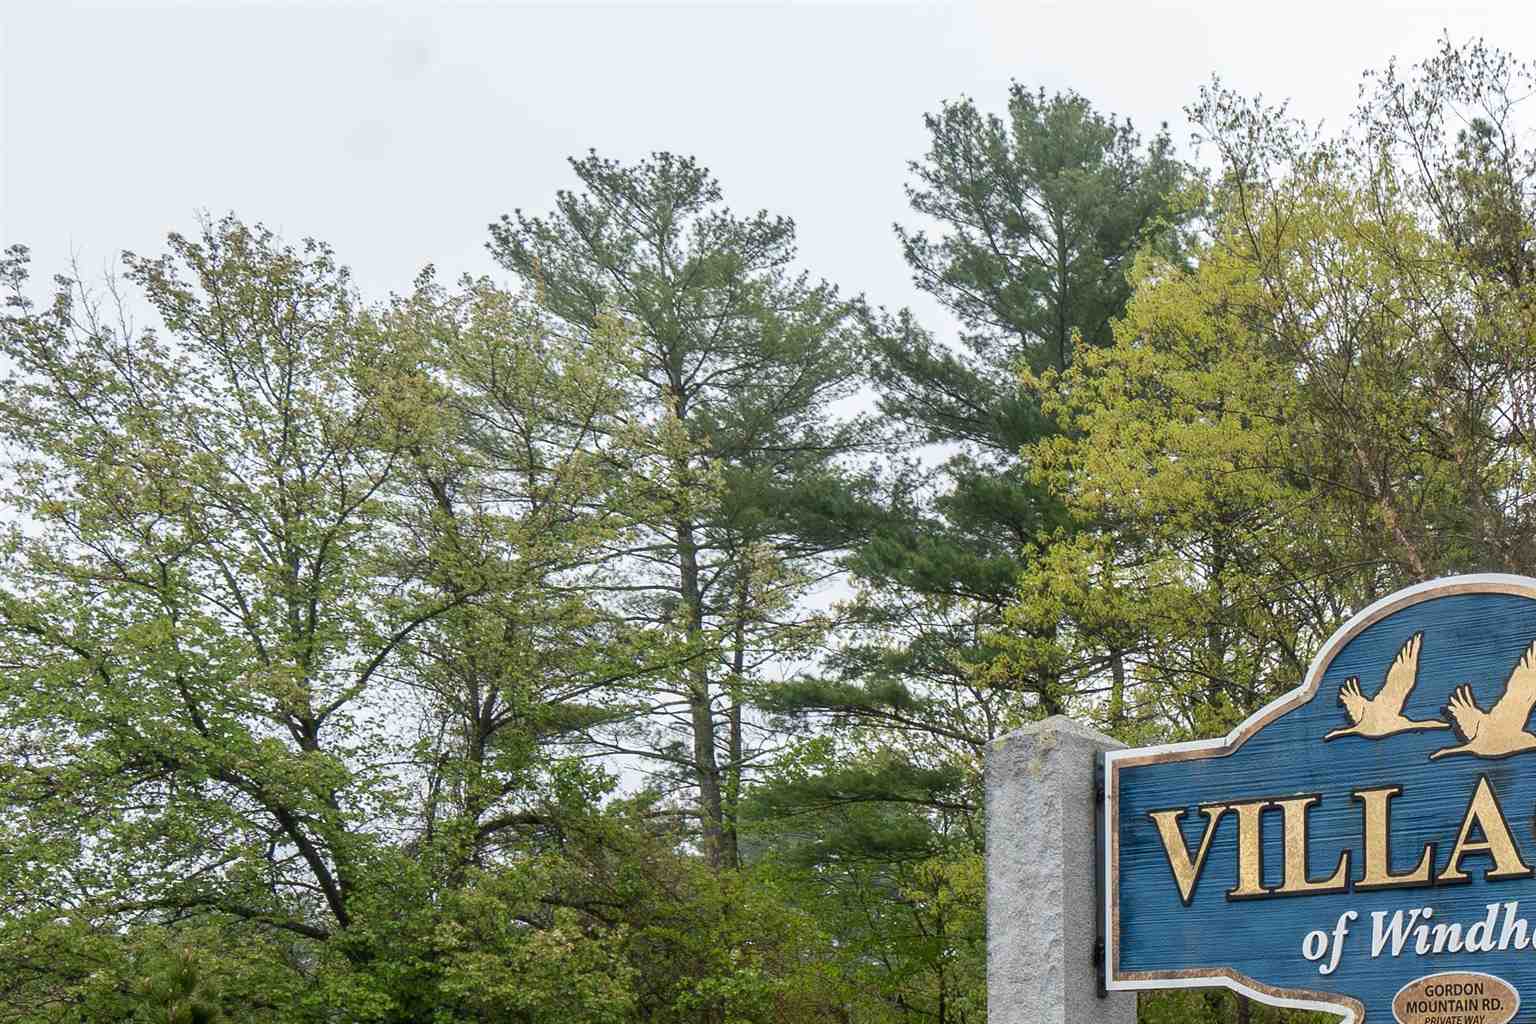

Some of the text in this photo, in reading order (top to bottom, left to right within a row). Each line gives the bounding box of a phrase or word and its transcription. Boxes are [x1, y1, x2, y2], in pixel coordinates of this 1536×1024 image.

[1302, 910, 1358, 974] of
[1424, 983, 1484, 997] GORDON
[1406, 998, 1504, 1013] MOUNTAIN RD.
[1464, 1015, 1486, 1024] WAY
